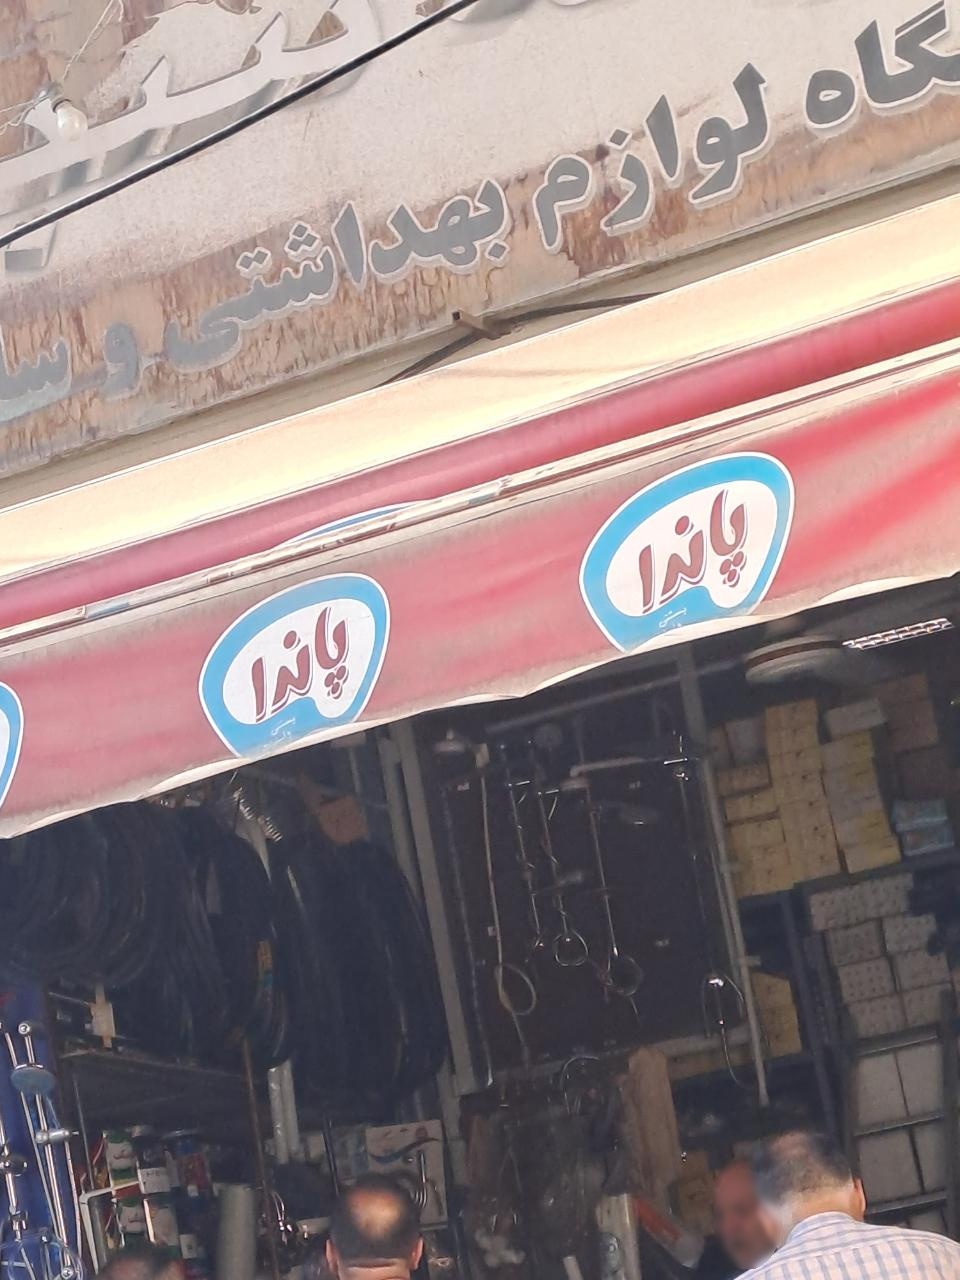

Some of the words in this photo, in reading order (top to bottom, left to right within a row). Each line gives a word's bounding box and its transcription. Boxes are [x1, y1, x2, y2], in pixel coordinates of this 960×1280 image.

[805, 2, 960, 130] گاه
[533, 62, 768, 252] لوازم
[164, 178, 508, 374] بهداشتی
[637, 489, 749, 614] پاندا
[251, 606, 351, 722] پاندا
